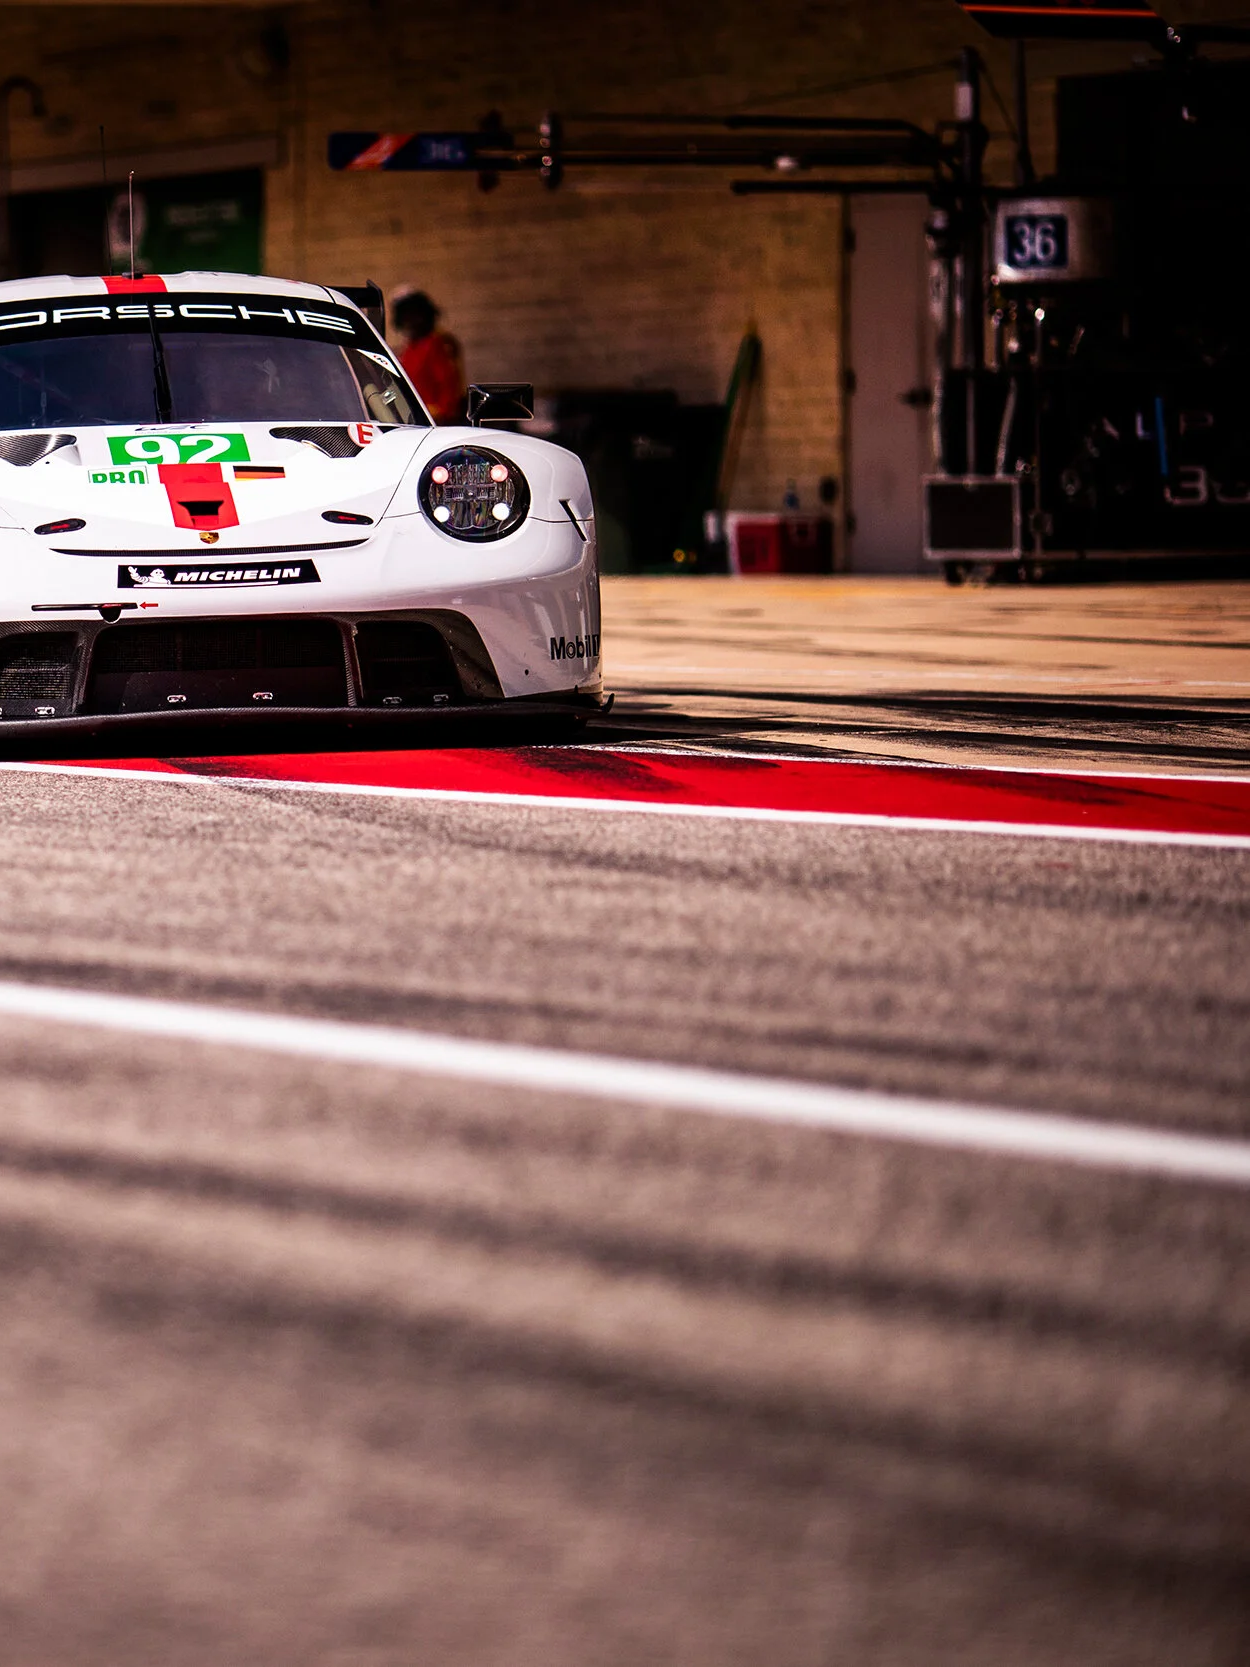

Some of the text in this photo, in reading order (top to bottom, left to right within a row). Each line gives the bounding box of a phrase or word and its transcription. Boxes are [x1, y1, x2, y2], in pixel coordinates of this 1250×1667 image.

[1013, 221, 1056, 261] 36
[356, 422, 374, 444] E
[124, 435, 232, 464] 92
[92, 470, 145, 484] PRO
[173, 567, 301, 582] MICHELIN
[550, 635, 591, 660] Mobil
